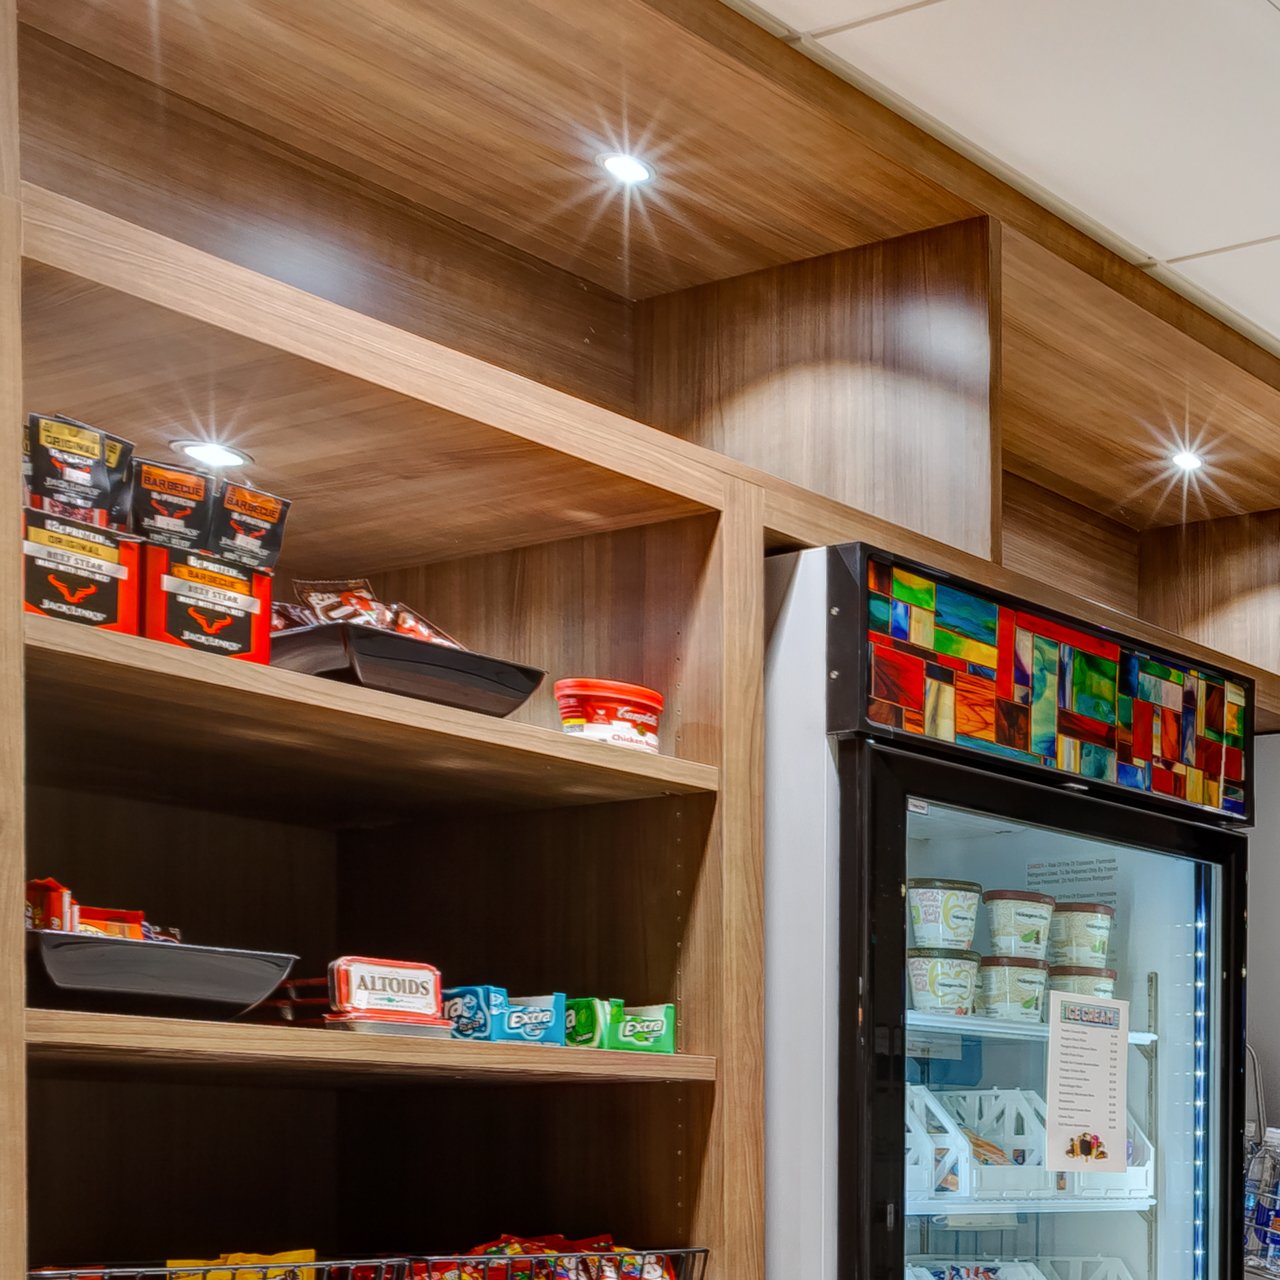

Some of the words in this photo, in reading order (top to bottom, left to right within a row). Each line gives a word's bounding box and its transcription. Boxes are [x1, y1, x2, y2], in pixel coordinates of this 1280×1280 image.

[357, 974, 430, 997] ALTOIDS
[509, 1008, 552, 1030] Extra
[624, 1019, 664, 1035] Extra
